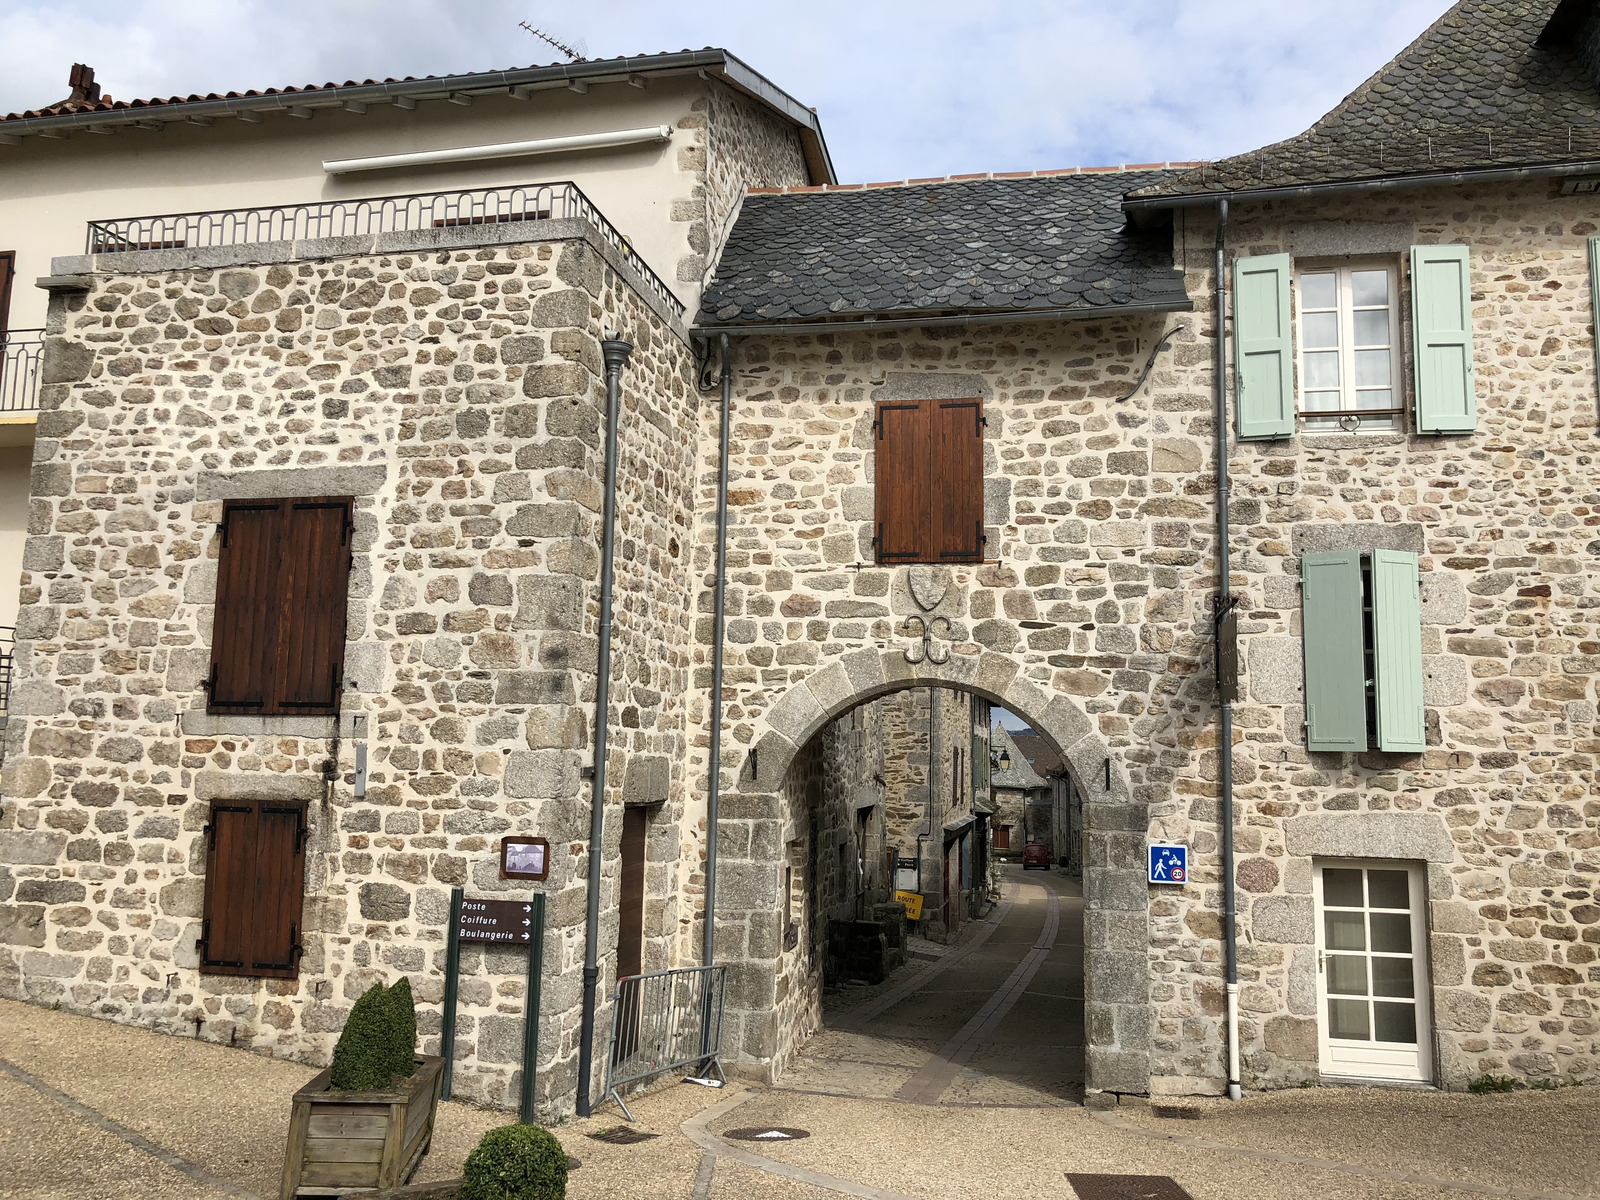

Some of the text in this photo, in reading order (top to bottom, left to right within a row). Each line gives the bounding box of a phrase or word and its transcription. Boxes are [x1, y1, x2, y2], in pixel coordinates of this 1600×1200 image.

[462, 902, 486, 910] Poste
[461, 915, 497, 924] Coiffure
[460, 929, 514, 940] Boulangerie
